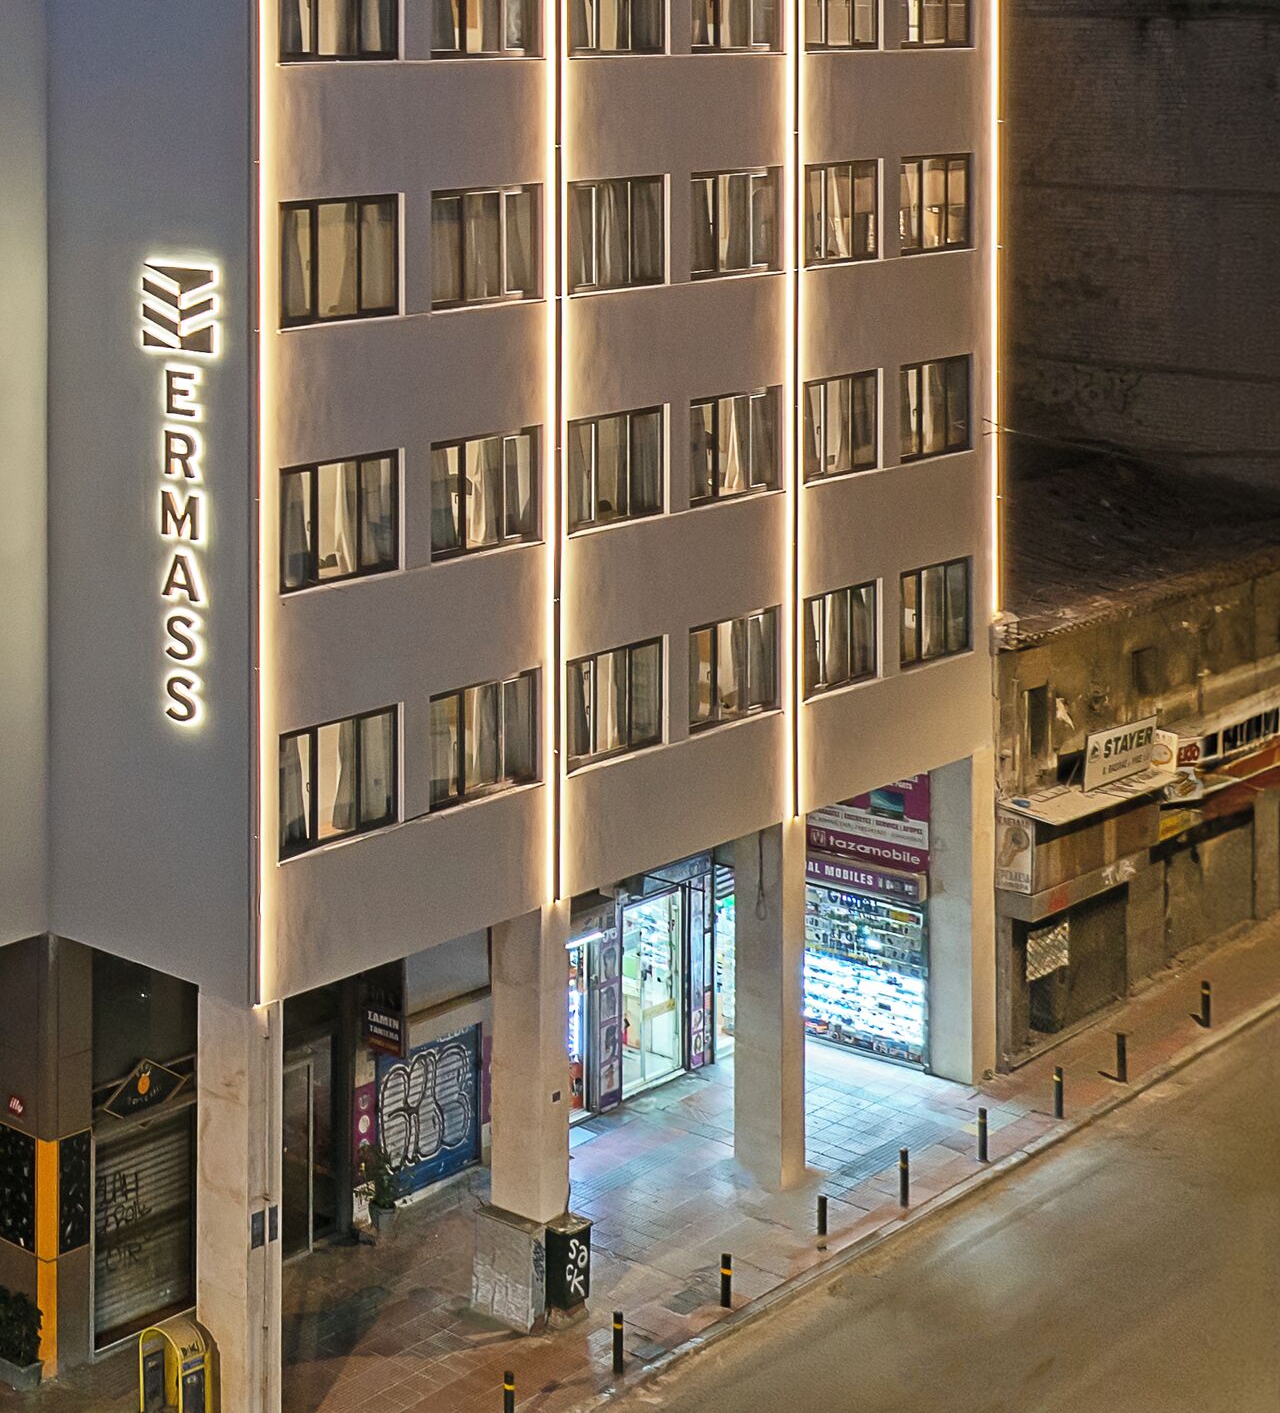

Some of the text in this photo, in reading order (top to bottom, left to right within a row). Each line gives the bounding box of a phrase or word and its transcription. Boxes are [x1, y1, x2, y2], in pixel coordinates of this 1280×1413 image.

[160, 369, 200, 722] ERMASS
[1104, 726, 1154, 758] STAYER
[829, 835, 921, 865] tazamobile
[824, 865, 874, 886] MOBILES
[9, 1096, 24, 1115] illy
